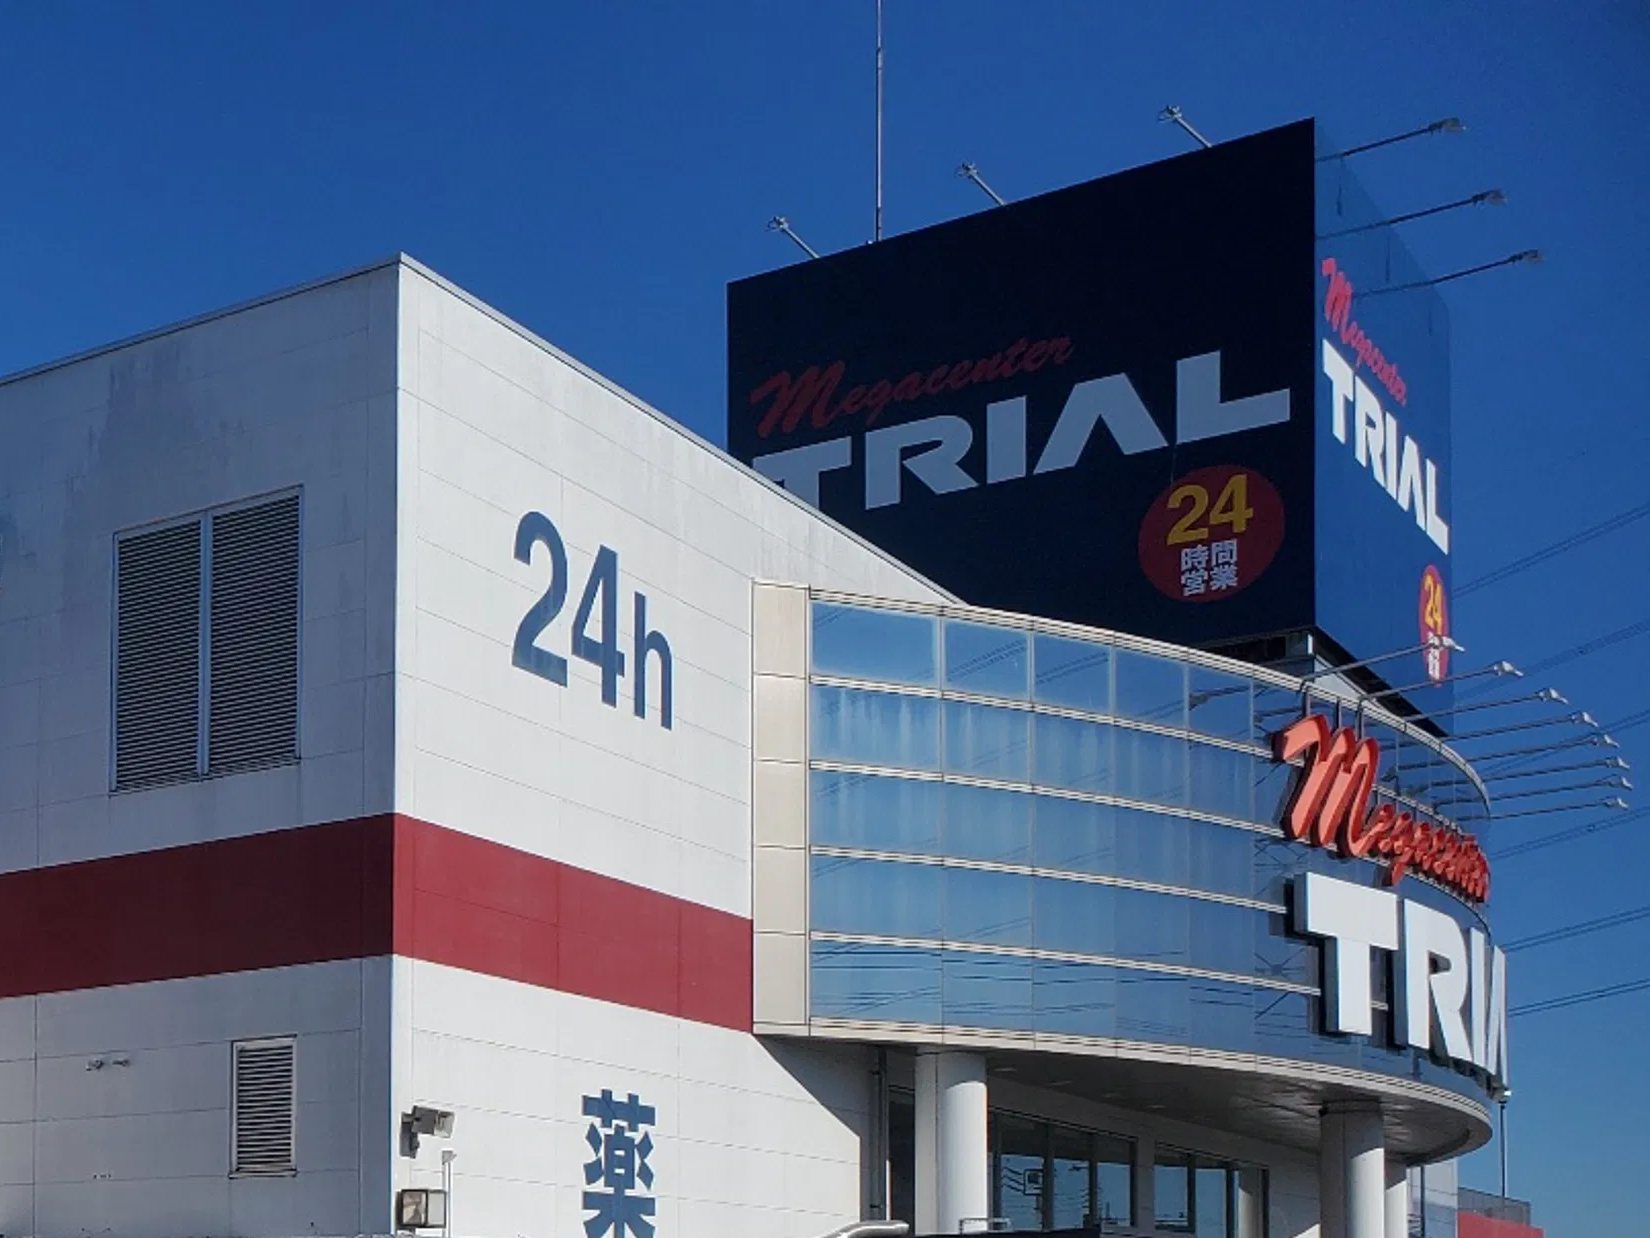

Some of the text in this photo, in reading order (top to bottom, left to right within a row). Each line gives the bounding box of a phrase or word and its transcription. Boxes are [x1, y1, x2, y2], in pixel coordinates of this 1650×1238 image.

[750, 336, 1076, 440] Megacenter
[752, 350, 1291, 512] TRIAL
[1322, 338, 1449, 555] TRIAL
[1166, 474, 1254, 546] 24
[1181, 539, 1238, 572] 時間
[1181, 564, 1238, 597] 営業
[512, 511, 673, 731] 24h
[1424, 574, 1443, 636] 24
